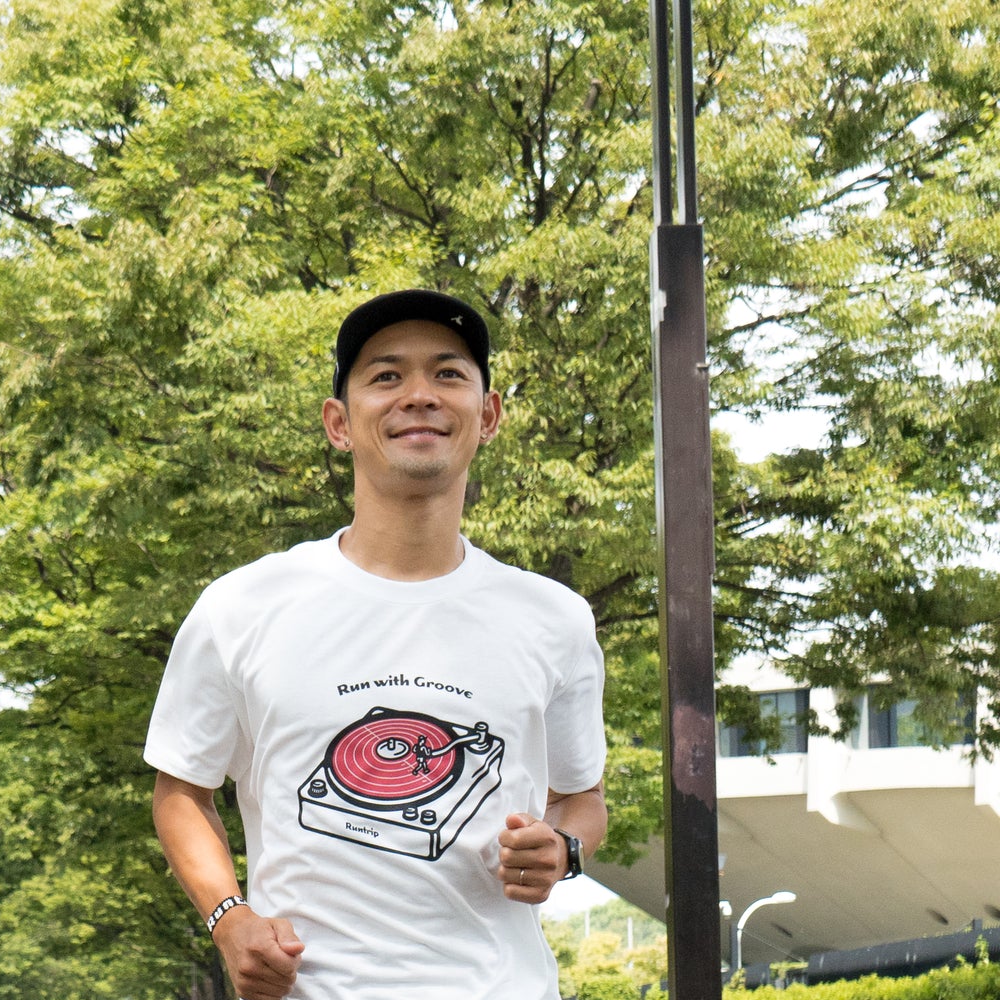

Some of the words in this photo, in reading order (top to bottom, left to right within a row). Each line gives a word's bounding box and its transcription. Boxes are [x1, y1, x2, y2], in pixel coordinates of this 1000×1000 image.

[337, 681, 370, 696] Run
[374, 674, 409, 686] with
[414, 676, 473, 699] Groove
[345, 822, 379, 838] Runtrip
